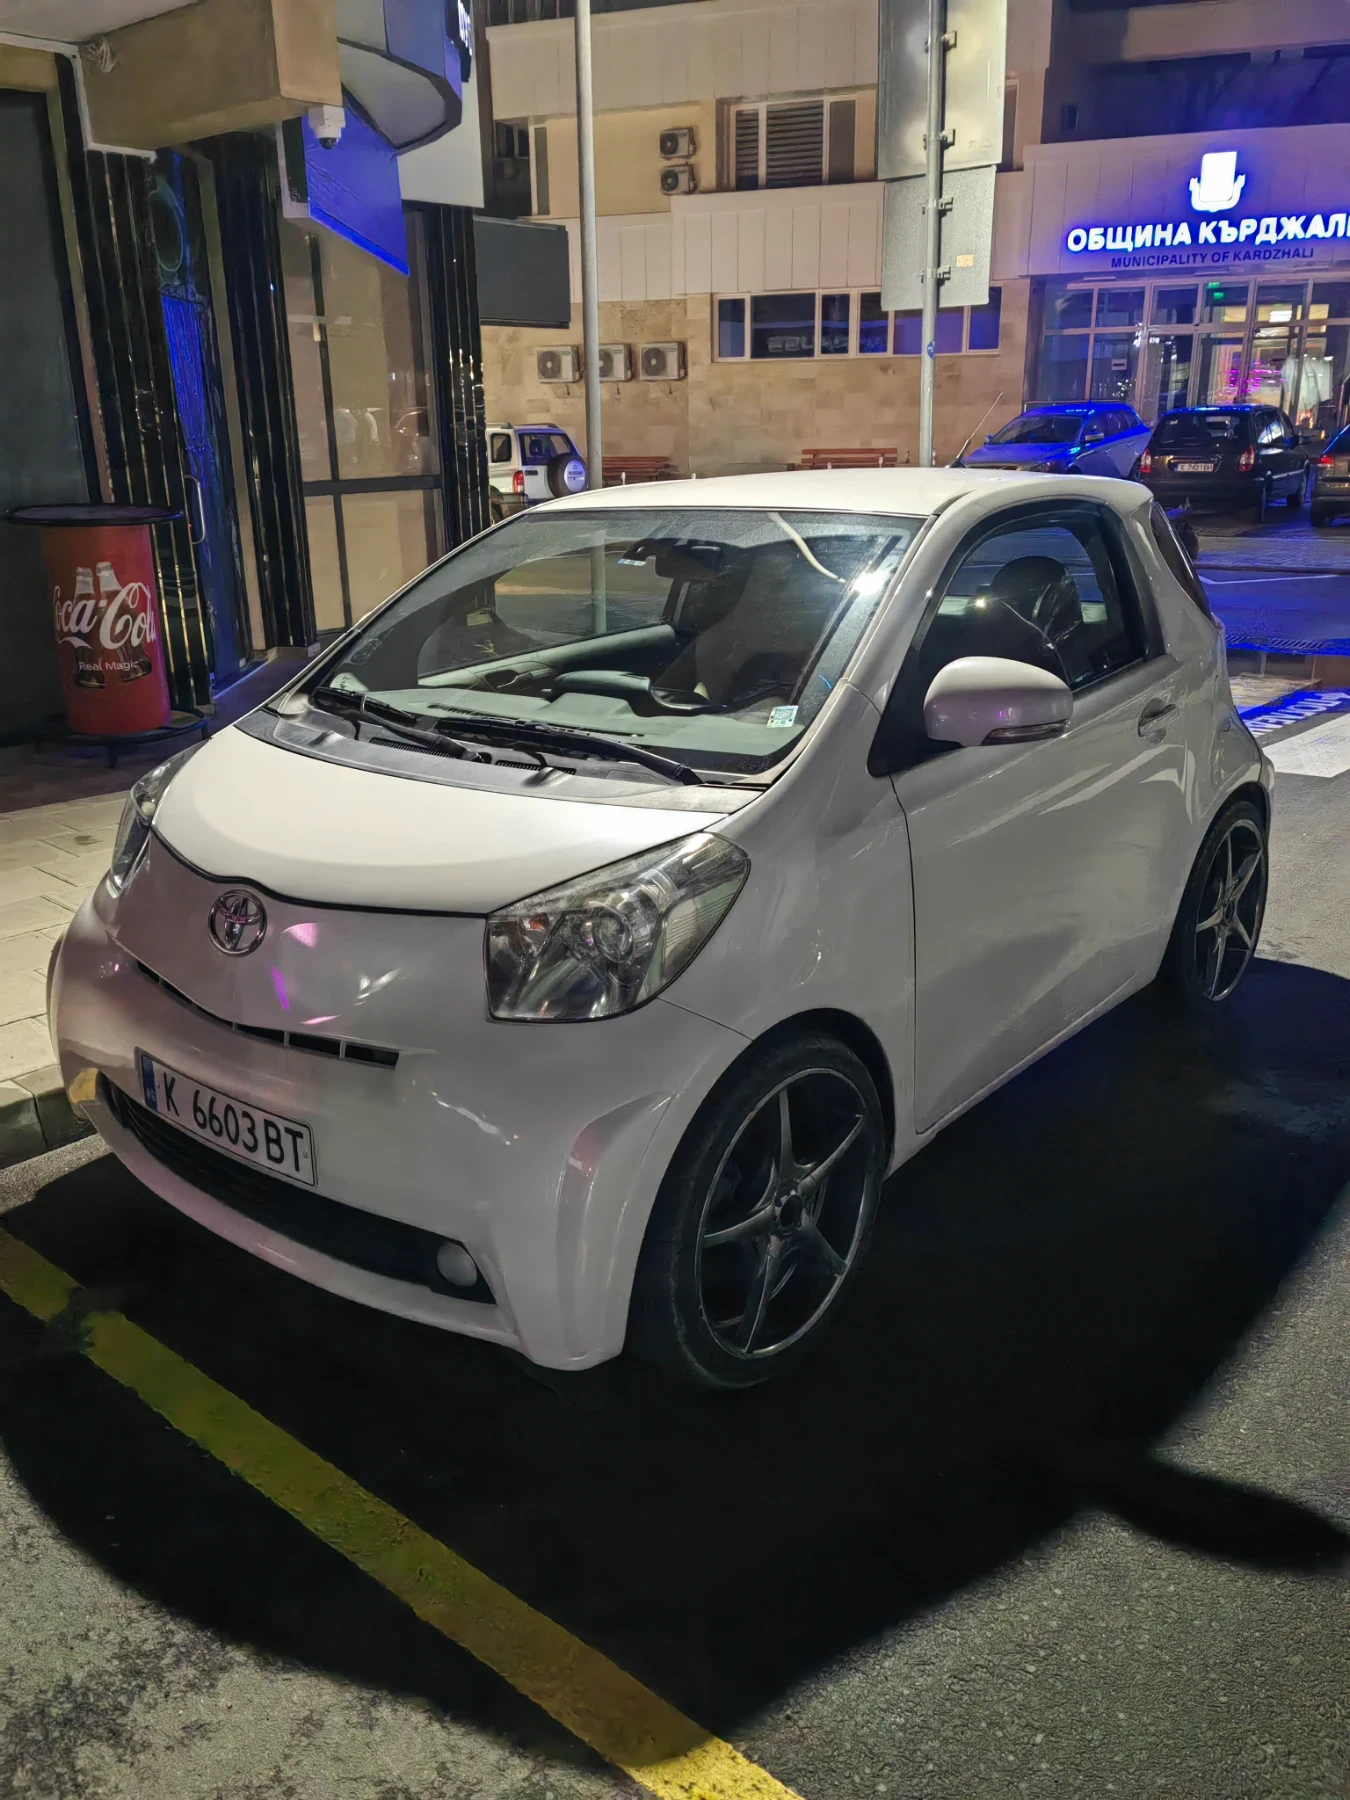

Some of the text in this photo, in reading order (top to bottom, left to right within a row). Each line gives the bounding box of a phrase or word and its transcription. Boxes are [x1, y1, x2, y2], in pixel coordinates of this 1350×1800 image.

[1067, 213, 1350, 252] ОБЩИНА КЪРДЖАЛ
[1111, 248, 1314, 268] MUNICIPALITY OF KARDZHALI
[79, 660, 139, 671] Real Magic
[163, 1071, 180, 1117] K
